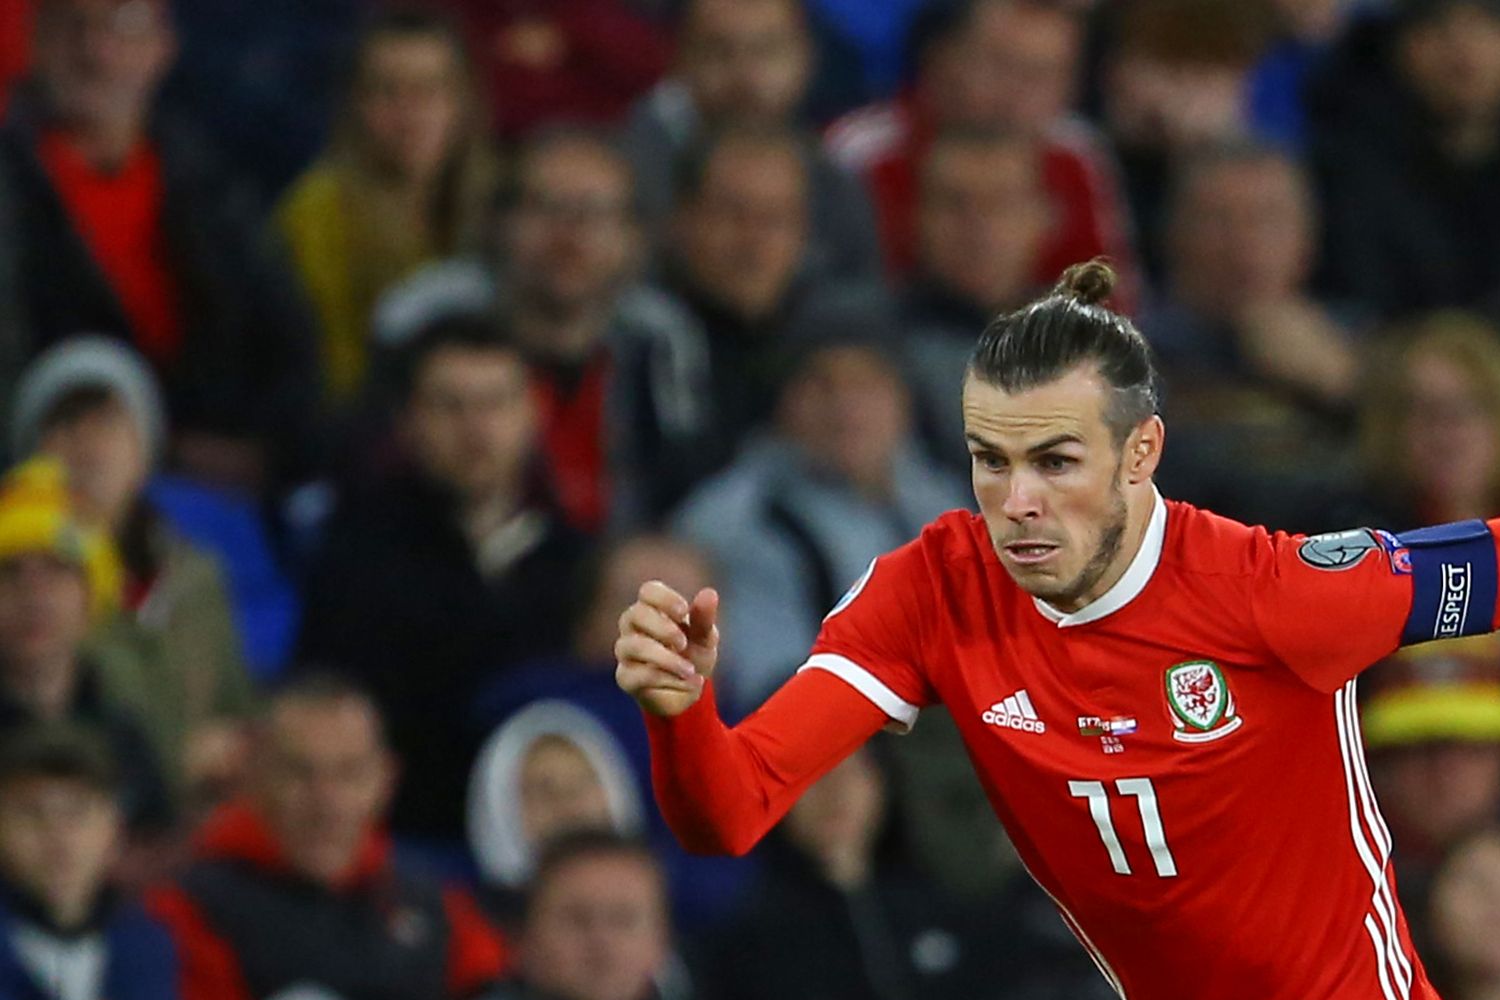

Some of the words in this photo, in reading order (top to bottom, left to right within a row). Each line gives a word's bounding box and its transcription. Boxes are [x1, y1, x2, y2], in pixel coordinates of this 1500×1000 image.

[1440, 564, 1465, 638] ESPECT
[982, 710, 1045, 734] adidas
[1068, 777, 1177, 877] 11
